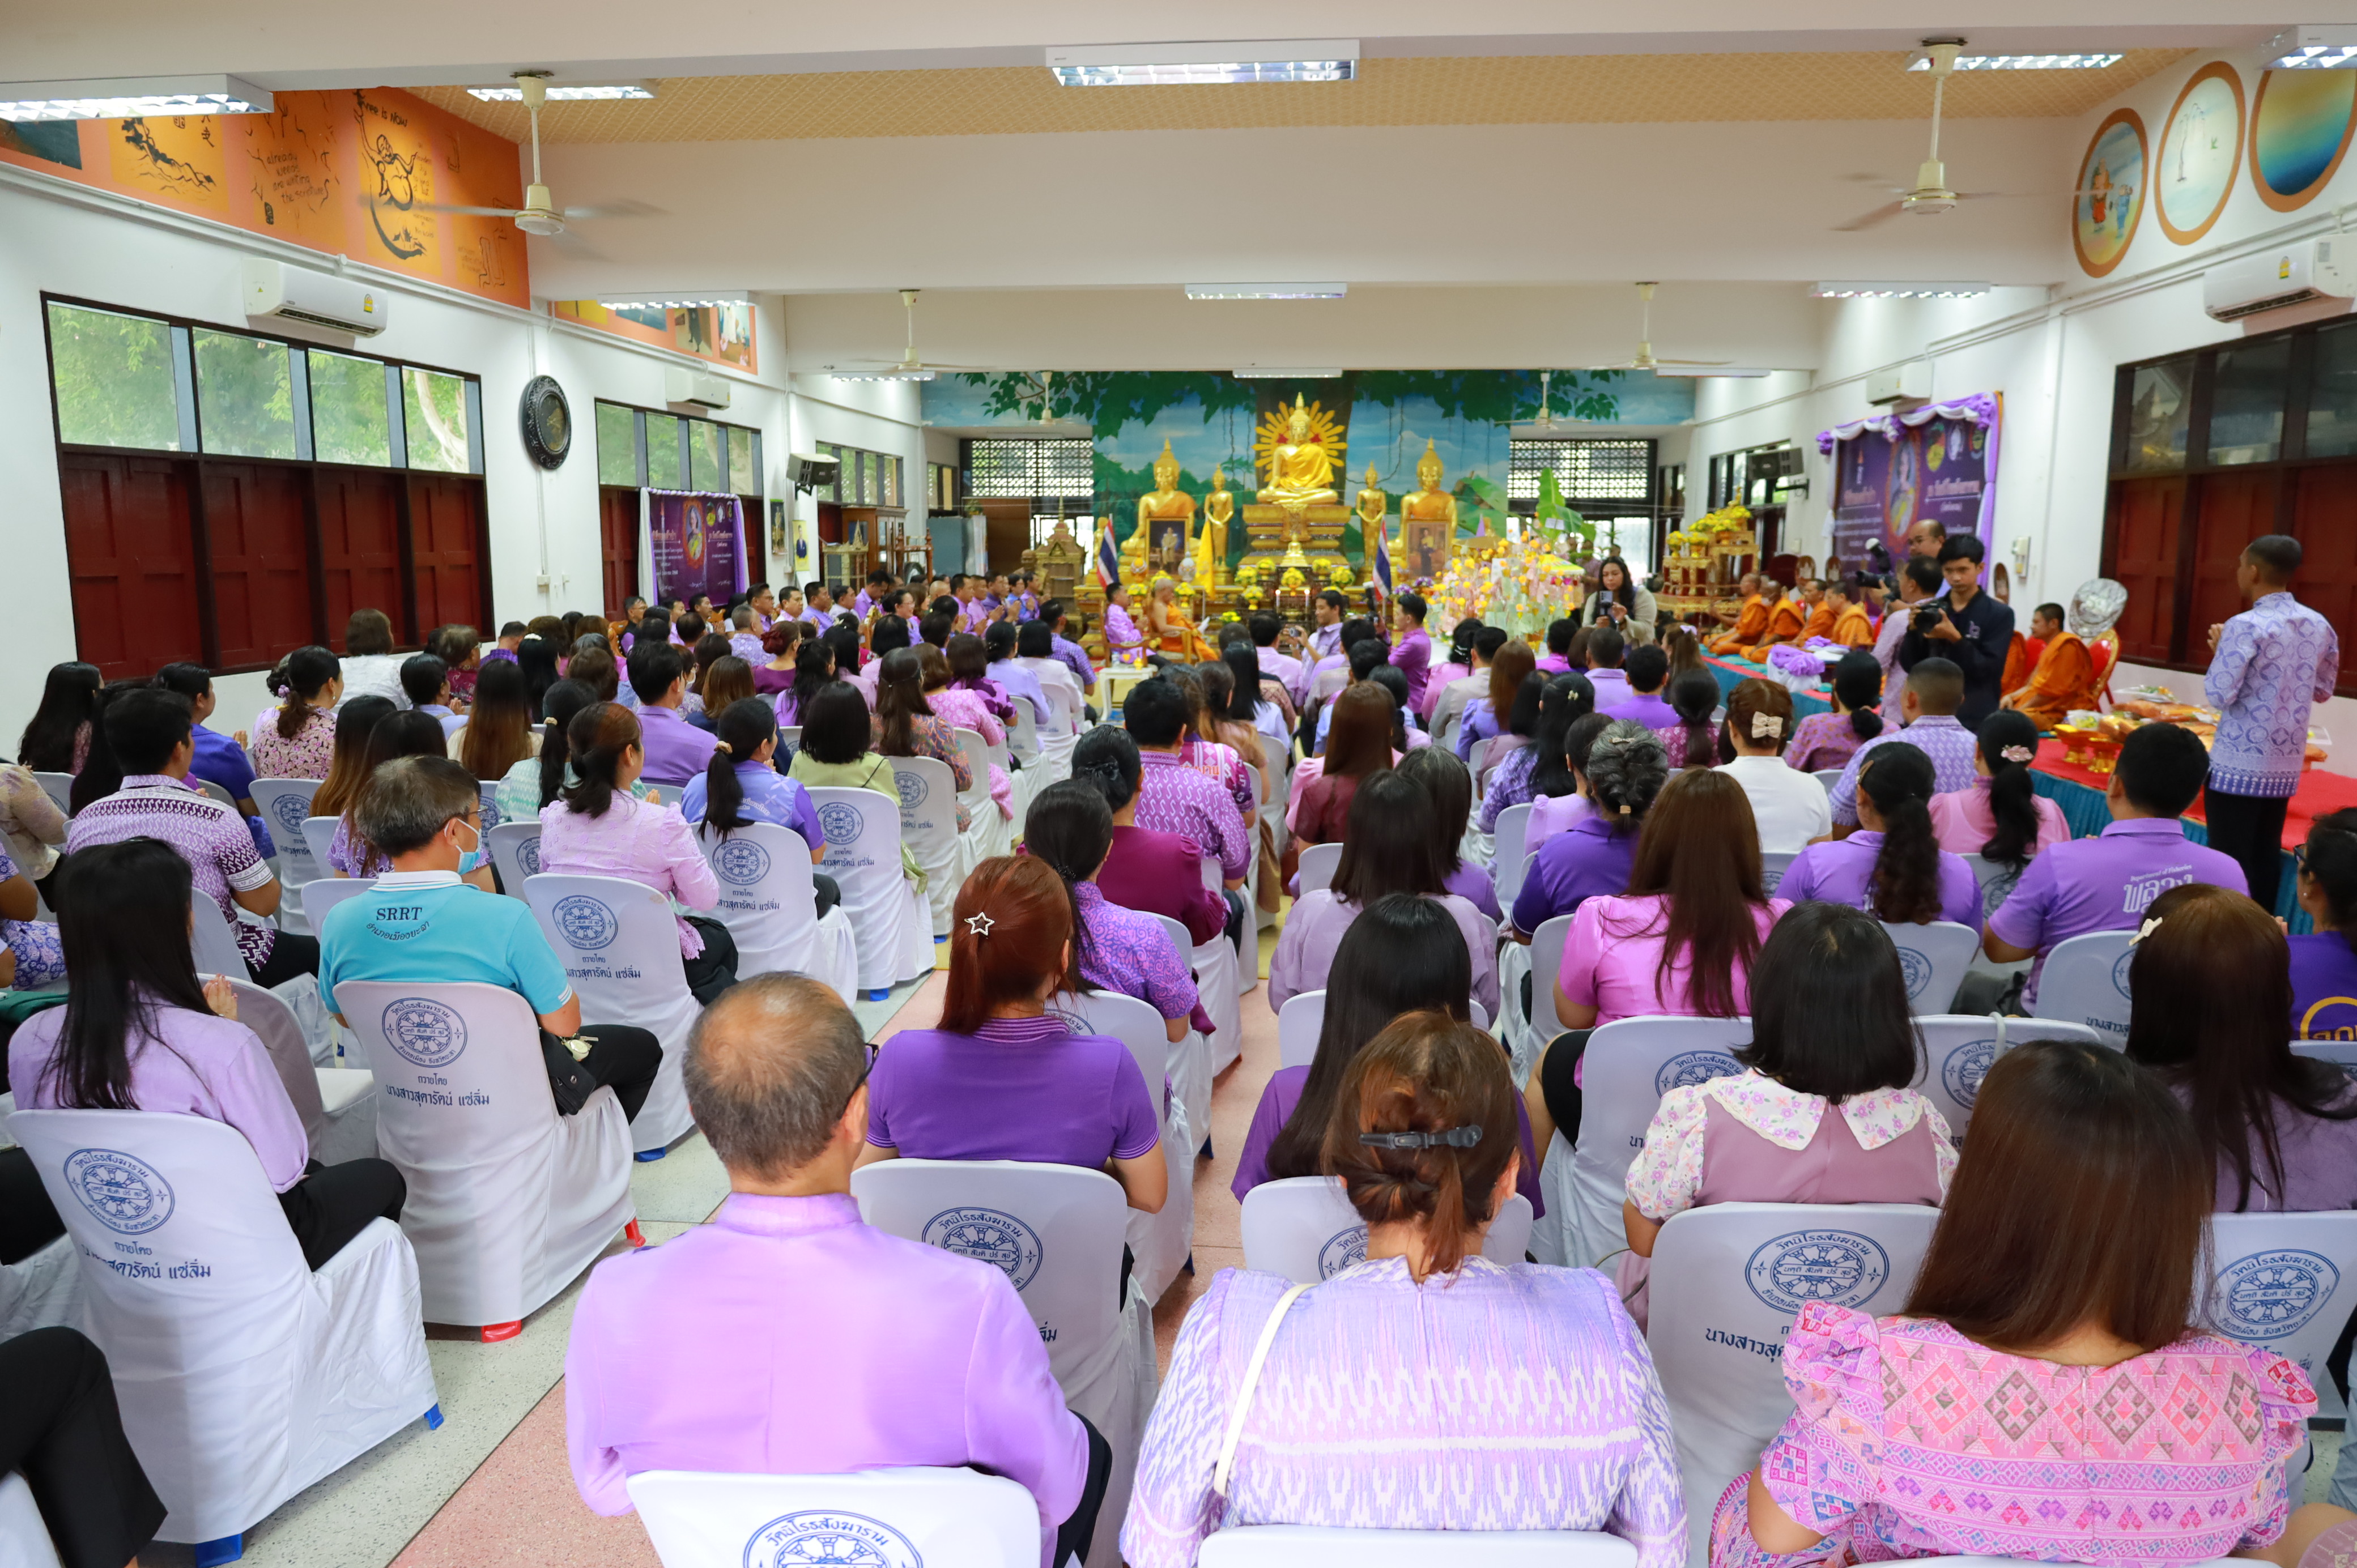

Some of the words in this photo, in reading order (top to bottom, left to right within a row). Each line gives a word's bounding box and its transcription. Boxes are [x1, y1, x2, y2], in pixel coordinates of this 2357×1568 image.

[733, 888, 754, 897] ถวายโดย
[759, 898, 780, 911] แซ่ลิ่ม
[376, 907, 422, 921] SRRT
[366, 921, 430, 940] อำเภอเมืองยะลา
[582, 953, 606, 963] ถวายโดย
[615, 965, 641, 979] แซ่ลิ่ม
[391, 1002, 451, 1019] วัดนิโรธสังฆาราม
[418, 1073, 448, 1085] ถวายโดย
[386, 1084, 453, 1107] นางสาวสุดารัตน์
[458, 1089, 490, 1106] แซ่ลิ่ม
[74, 1152, 149, 1178] วัดนิโรธสังฆาราม
[938, 1211, 1023, 1237] วัดนิโรธสังฆาราม
[114, 1241, 152, 1255] ถวายโดย
[1775, 1233, 1873, 1256] วัดนิโรธสังฆาราม
[169, 1259, 211, 1279] แซ่ลิ่ม
[2230, 1254, 2325, 1278] วัดนิโรธสังฆาราม
[765, 1517, 890, 1546] วัดนิโรธสังฆาราม
